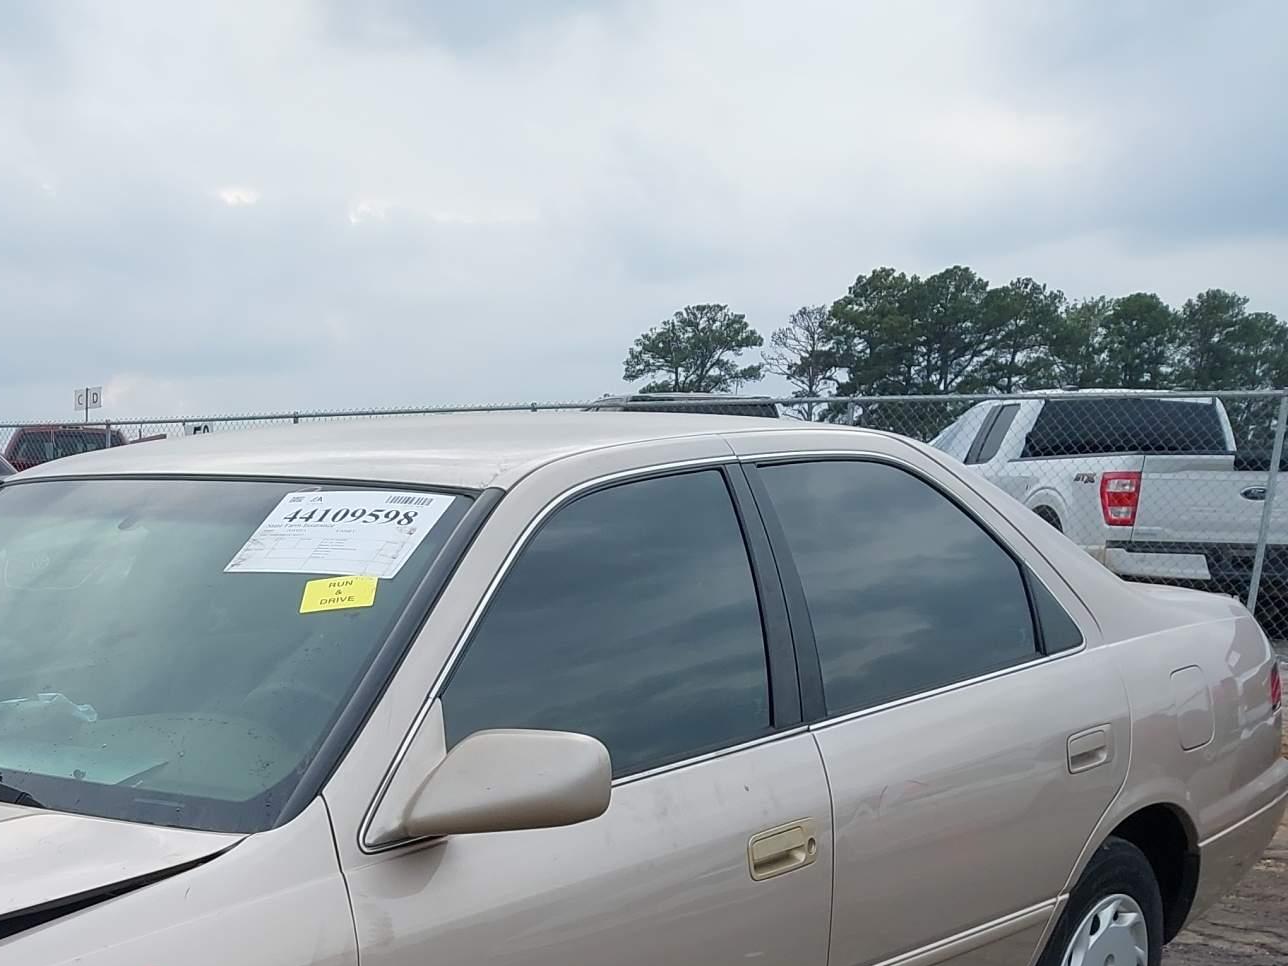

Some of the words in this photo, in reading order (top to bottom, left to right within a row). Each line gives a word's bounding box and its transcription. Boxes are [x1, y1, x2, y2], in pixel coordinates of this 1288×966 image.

[78, 394, 84, 405] C
[92, 392, 98, 404] D
[283, 508, 419, 526] 44109598
[328, 580, 354, 588] RUN
[319, 595, 356, 605] DRIVE
